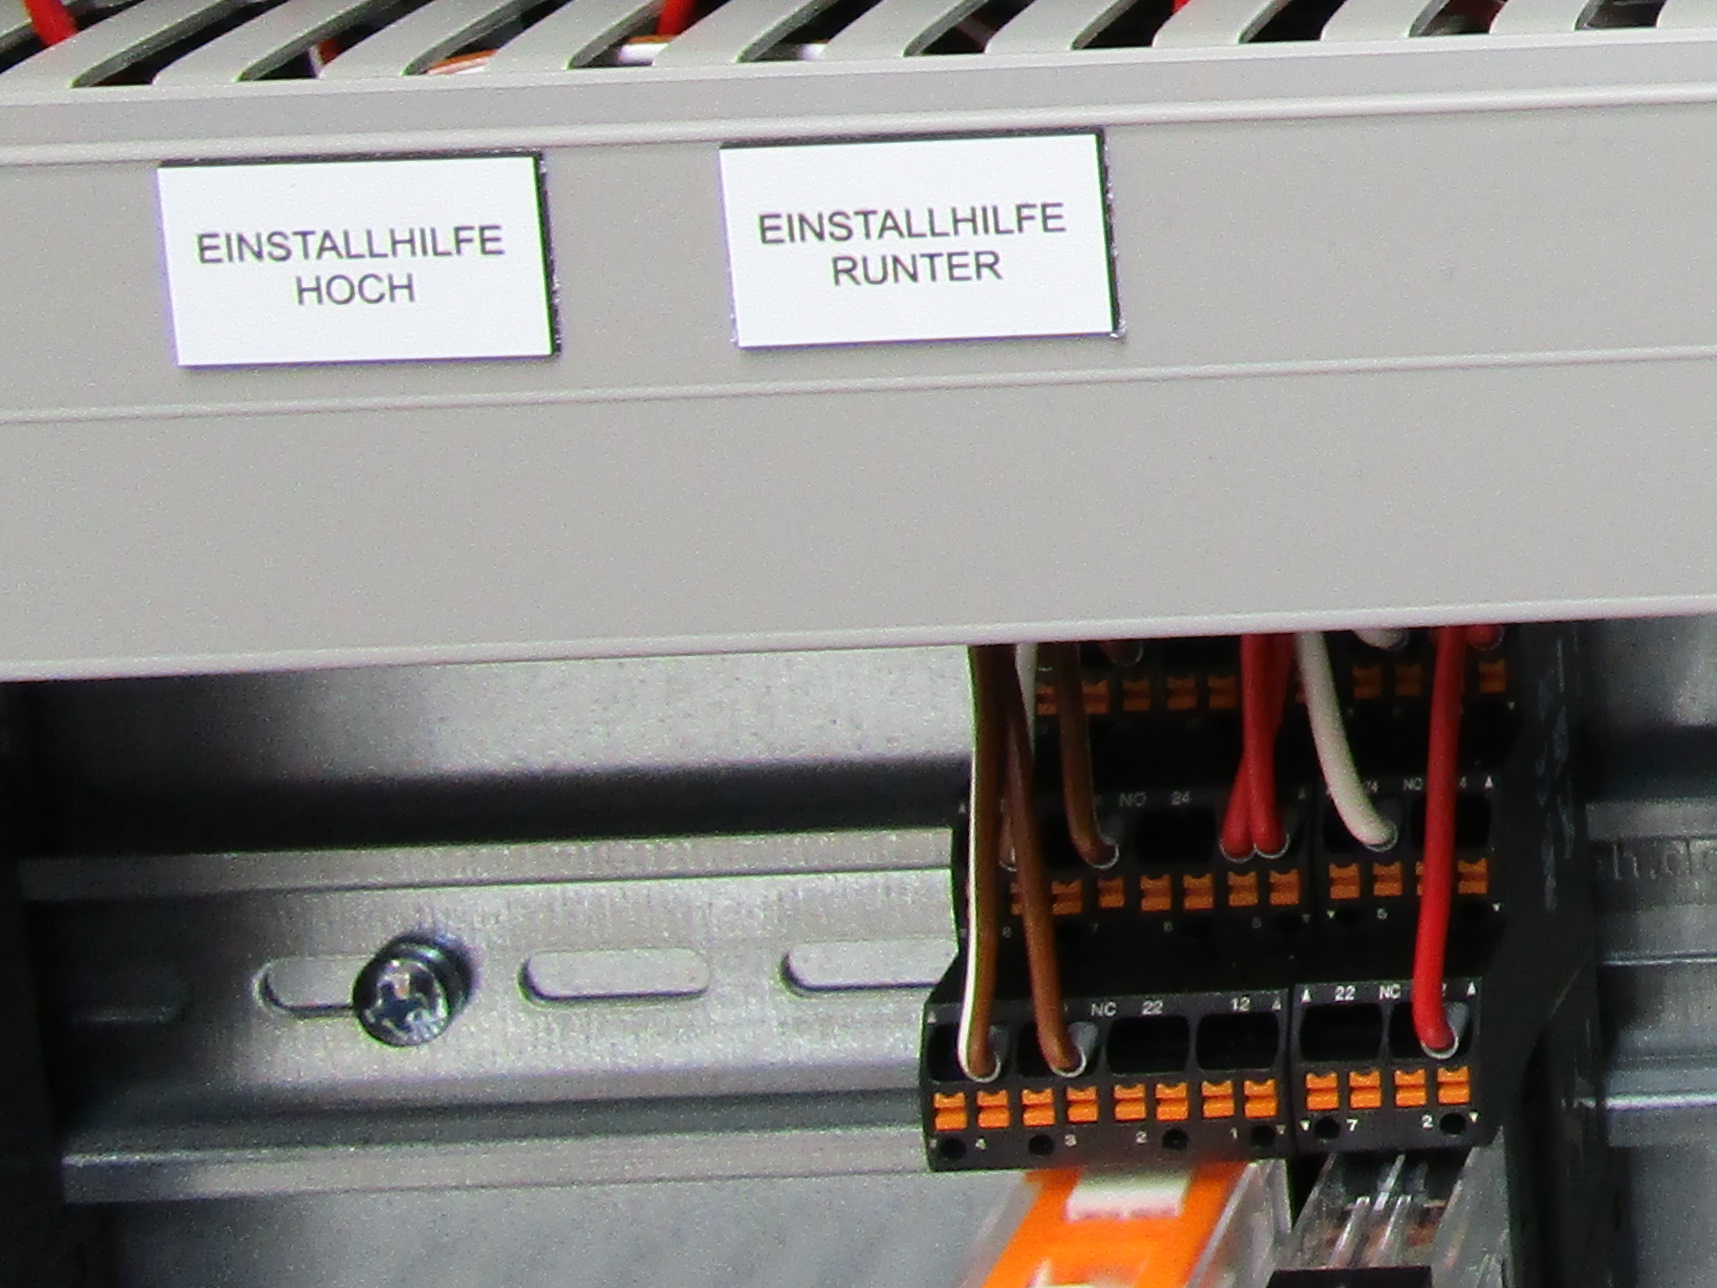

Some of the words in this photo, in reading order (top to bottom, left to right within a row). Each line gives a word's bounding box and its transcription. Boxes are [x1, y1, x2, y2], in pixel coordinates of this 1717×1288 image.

[757, 201, 1067, 245] EINSTALLHILFE
[197, 224, 505, 266] EINSTALLHILFE
[831, 249, 1003, 288] RUNTER
[296, 272, 417, 308] HOCH
